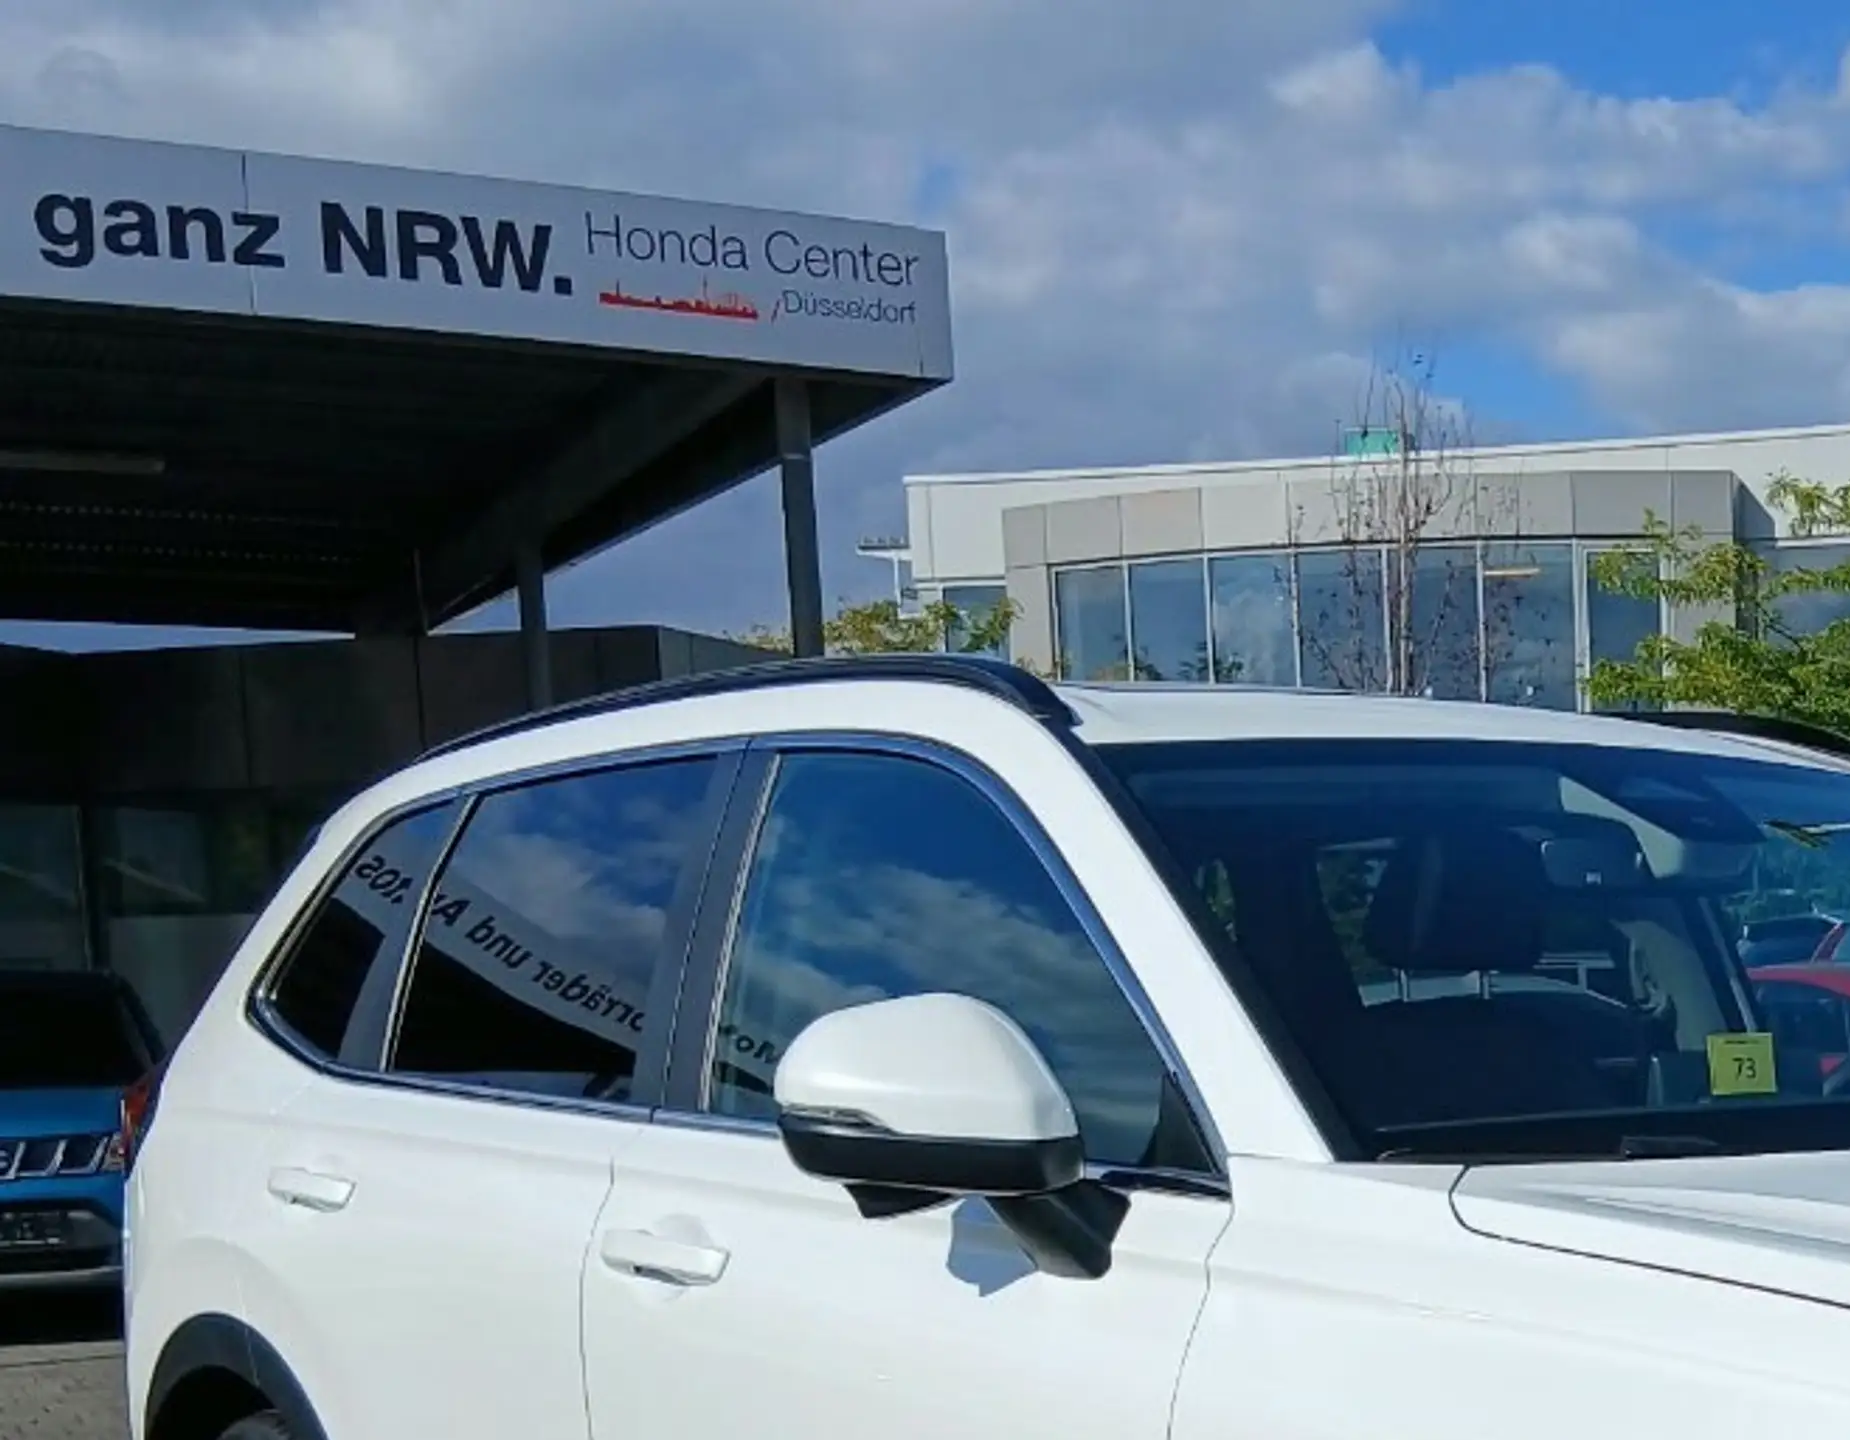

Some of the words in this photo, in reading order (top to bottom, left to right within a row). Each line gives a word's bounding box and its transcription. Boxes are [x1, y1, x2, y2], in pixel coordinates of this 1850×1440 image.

[34, 194, 286, 268] ganz
[320, 201, 574, 296] NRW.
[585, 211, 749, 271] Honda
[764, 230, 920, 286] Center
[1732, 1057, 1757, 1081] 73
